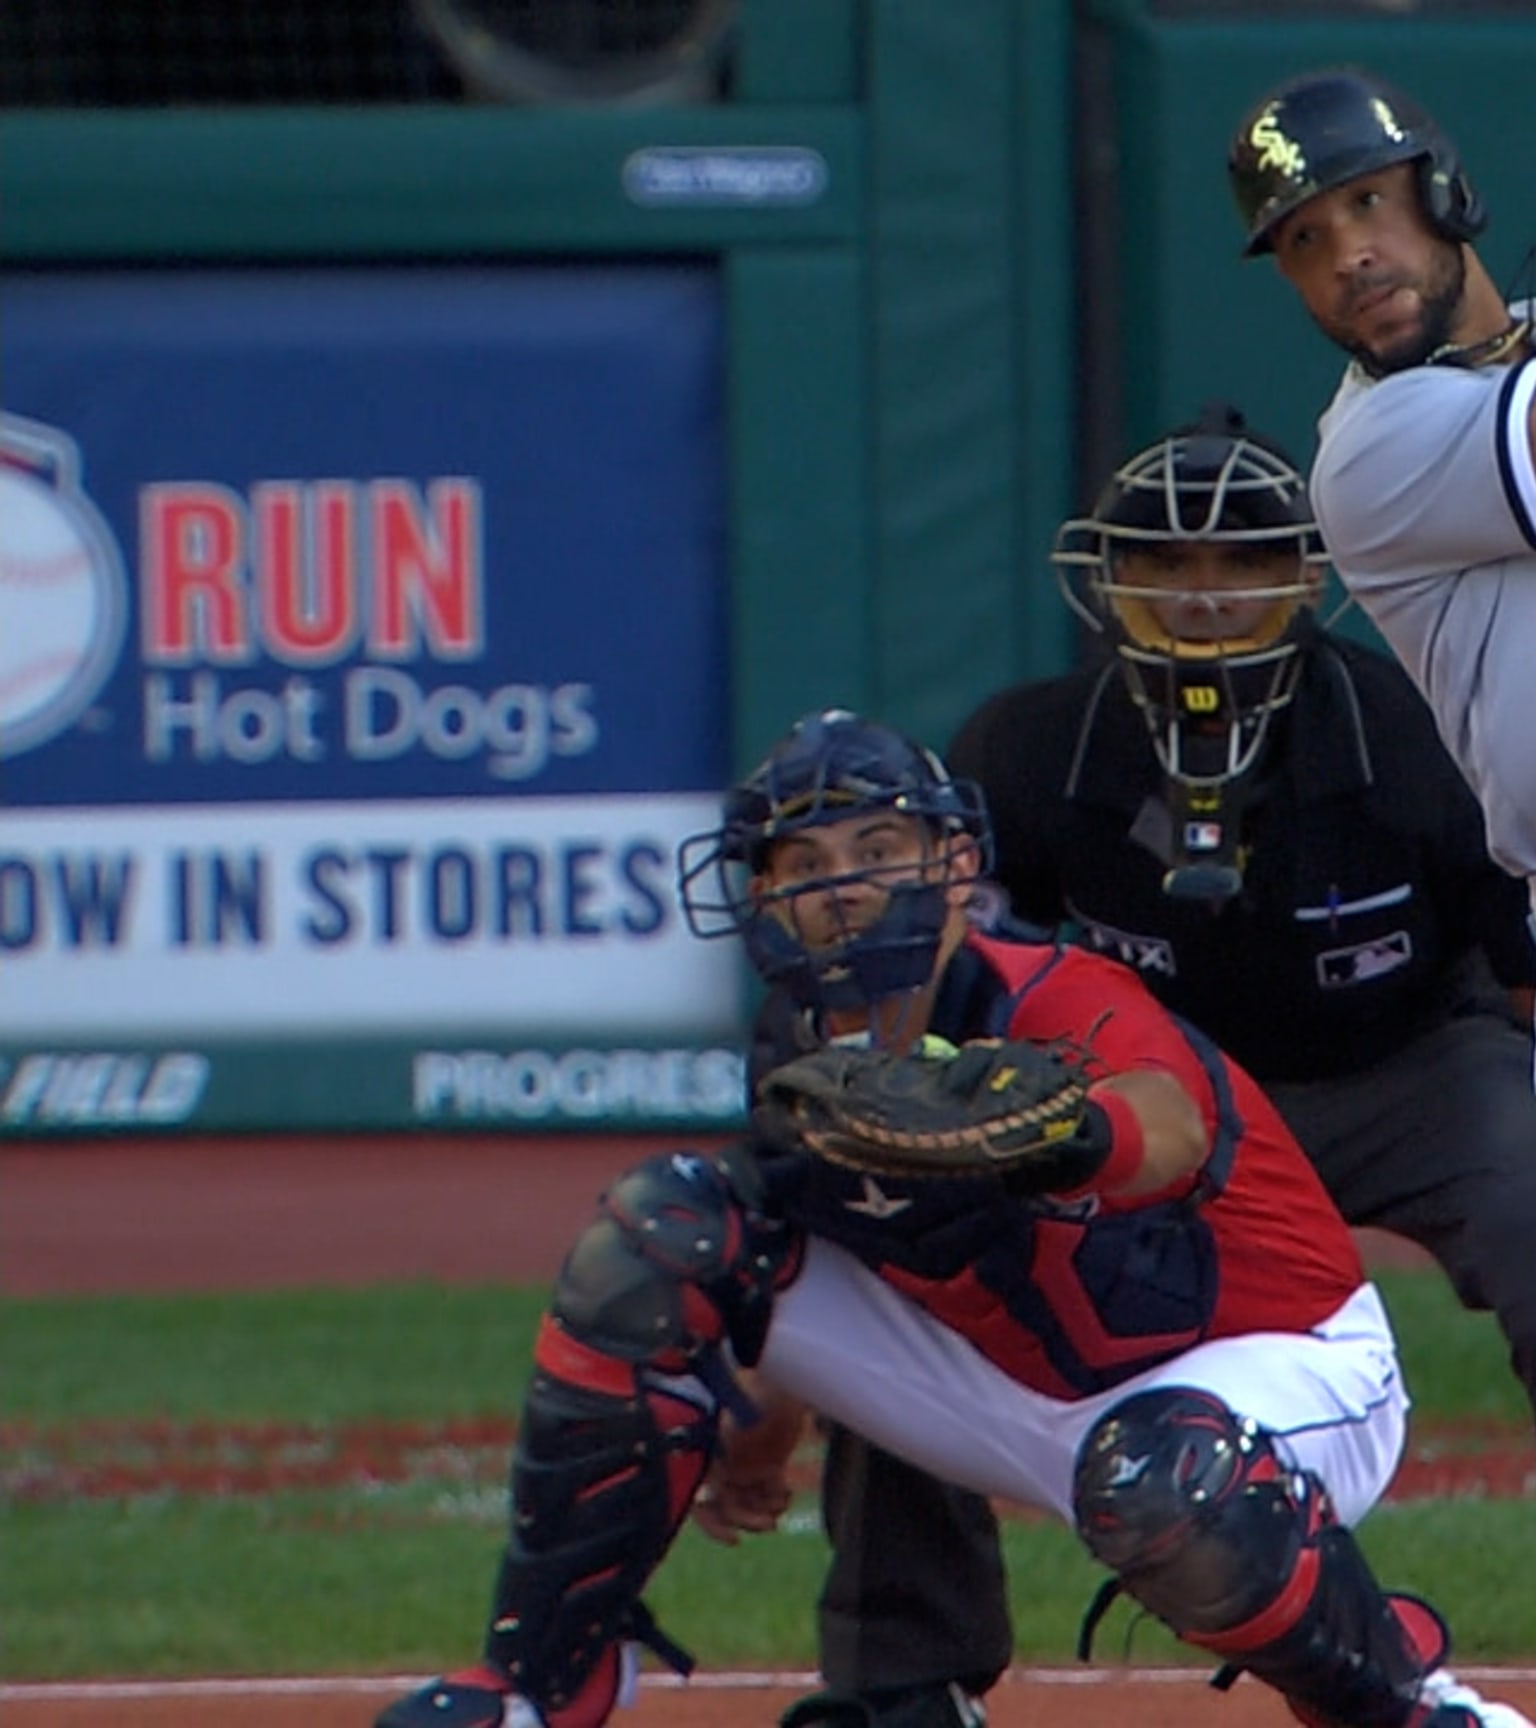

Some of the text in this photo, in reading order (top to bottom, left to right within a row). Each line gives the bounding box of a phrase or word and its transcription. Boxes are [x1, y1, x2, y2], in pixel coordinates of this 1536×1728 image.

[140, 477, 485, 670] RUN
[144, 666, 599, 782] Hot Dogs
[0, 843, 667, 951] OW IN STORES
[2, 1052, 210, 1127] FIELD
